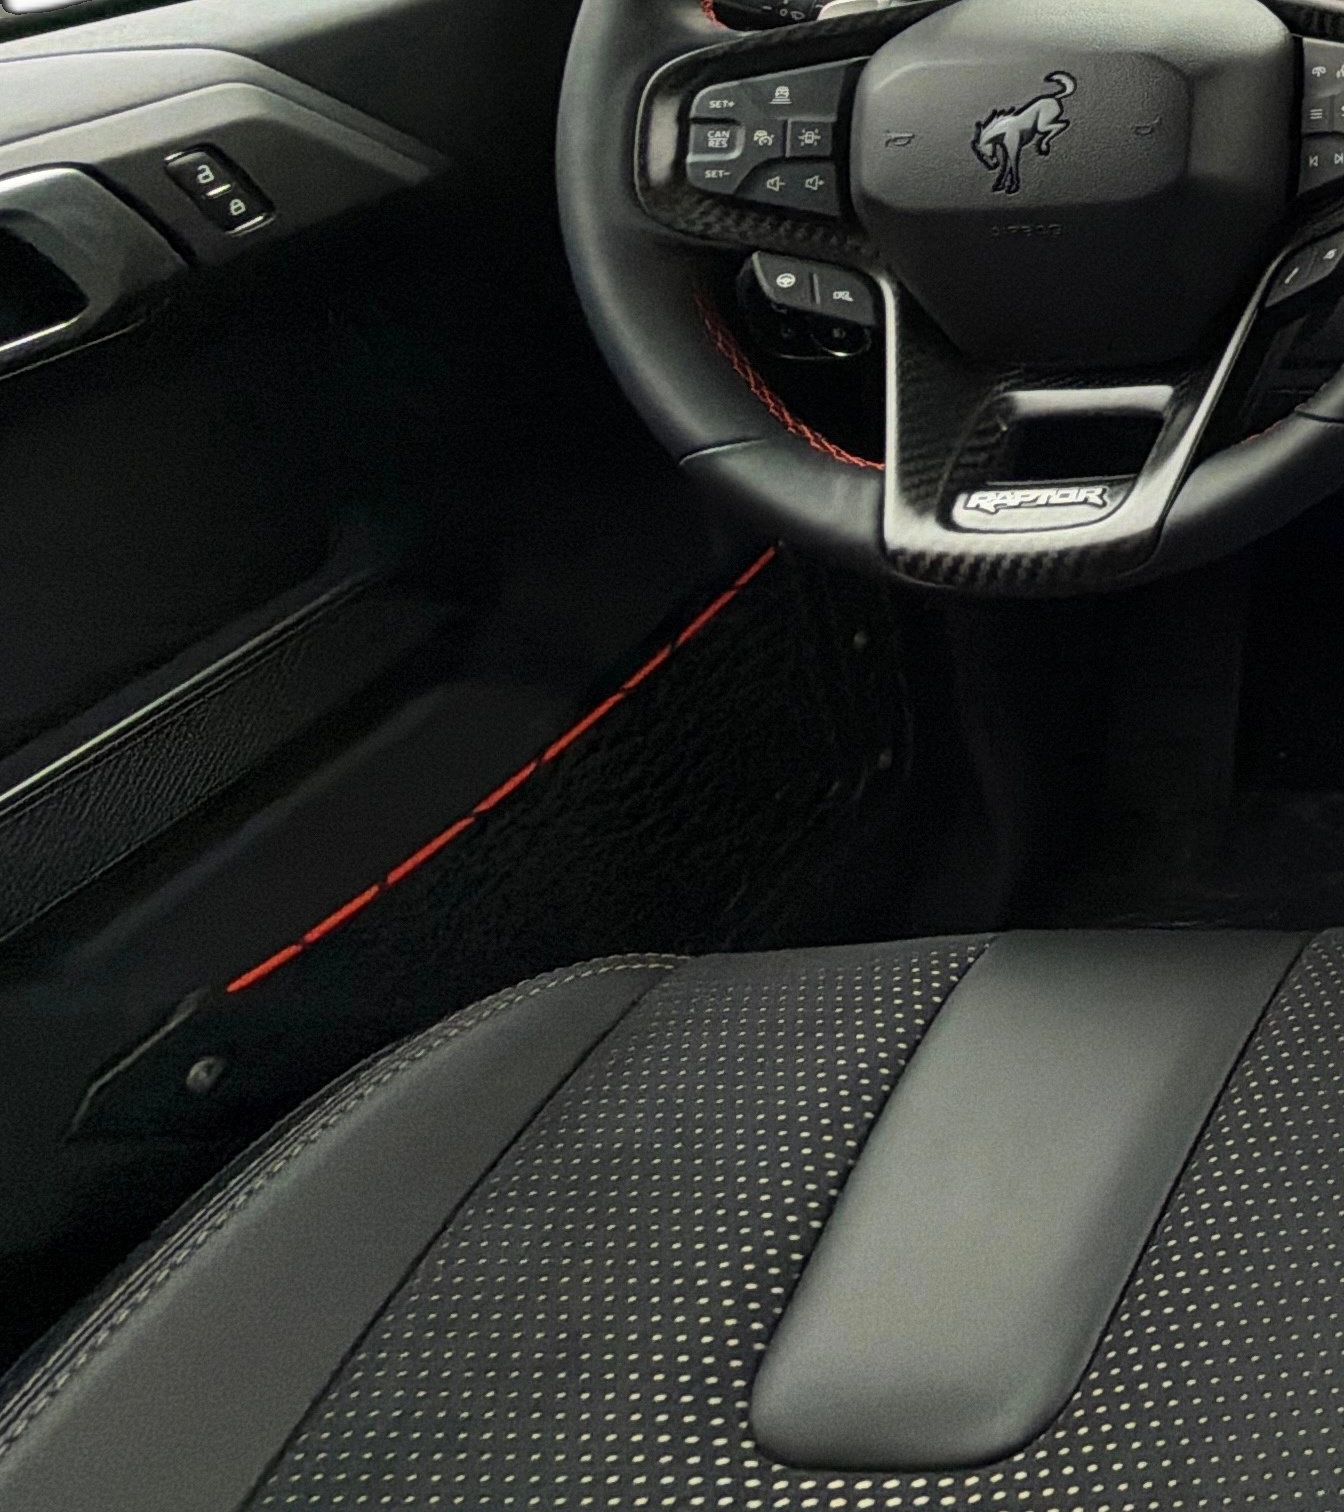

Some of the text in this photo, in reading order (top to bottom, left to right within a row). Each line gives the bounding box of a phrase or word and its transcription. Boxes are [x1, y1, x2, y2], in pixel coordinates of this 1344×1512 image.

[707, 130, 730, 139] CAN
[707, 138, 728, 148] RES
[966, 486, 1106, 513] RAPTOR
